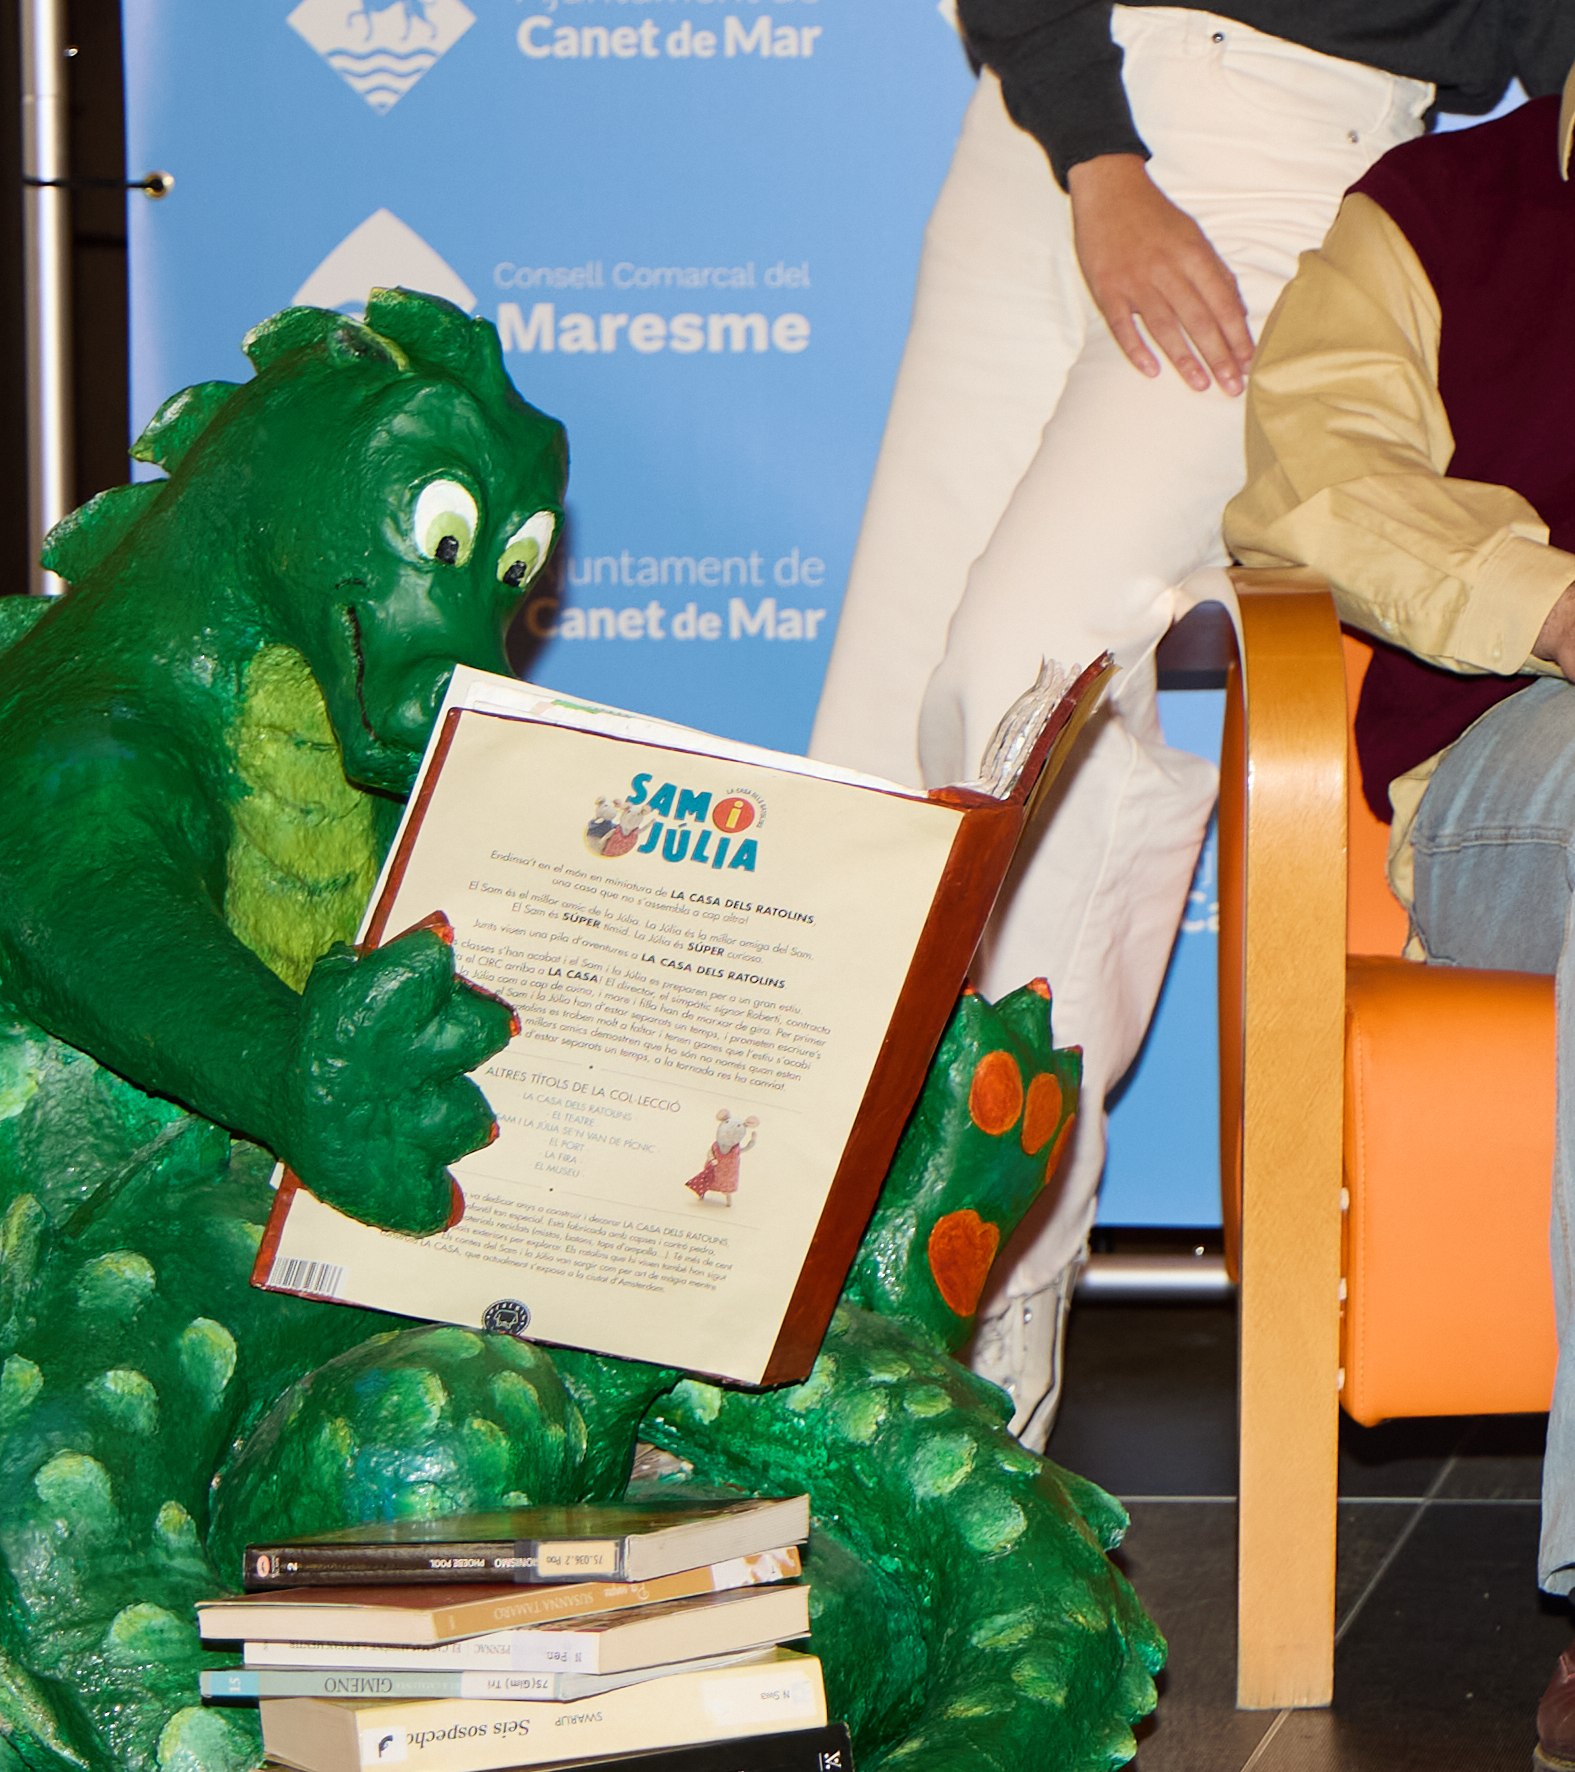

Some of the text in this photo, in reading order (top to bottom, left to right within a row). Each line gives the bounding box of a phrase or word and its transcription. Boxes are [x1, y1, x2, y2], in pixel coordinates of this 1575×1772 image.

[518, 16, 822, 58] Canet de Mar
[494, 262, 810, 289] Consell Comarcal del
[497, 303, 811, 352] Maresme
[774, 548, 825, 585] de
[673, 601, 722, 640] de
[730, 598, 827, 640] Mar
[626, 773, 713, 823] SAM
[637, 821, 760, 873] JÚLIA
[670, 889, 685, 901] LA
[689, 892, 720, 908] CASA
[725, 899, 752, 913] DELS
[562, 910, 601, 929] SÚPER
[688, 940, 725, 958] SÚPER
[548, 966, 562, 978] LA
[641, 953, 656, 965] LA
[660, 957, 692, 972] CASA
[697, 964, 724, 978] DELS
[486, 1066, 527, 1082] ALTRES
[531, 1072, 569, 1090] TÍTOLS
[572, 1082, 589, 1094] DE
[592, 1086, 605, 1097] LA
[429, 1558, 452, 1568] POOL
[452, 1558, 485, 1568] PHOEBE
[565, 1553, 603, 1565] 75.036.2
[492, 1598, 541, 1620] TAMARO
[541, 1590, 594, 1612] SUSANNA
[473, 1642, 511, 1655] PENNAC
[545, 1650, 568, 1662] Pen
[229, 1676, 242, 1693] 15
[324, 1676, 392, 1693] GIMENO
[487, 1678, 501, 1689] Tri
[493, 1717, 530, 1738] Seis
[554, 1711, 603, 1727] SWARUP
